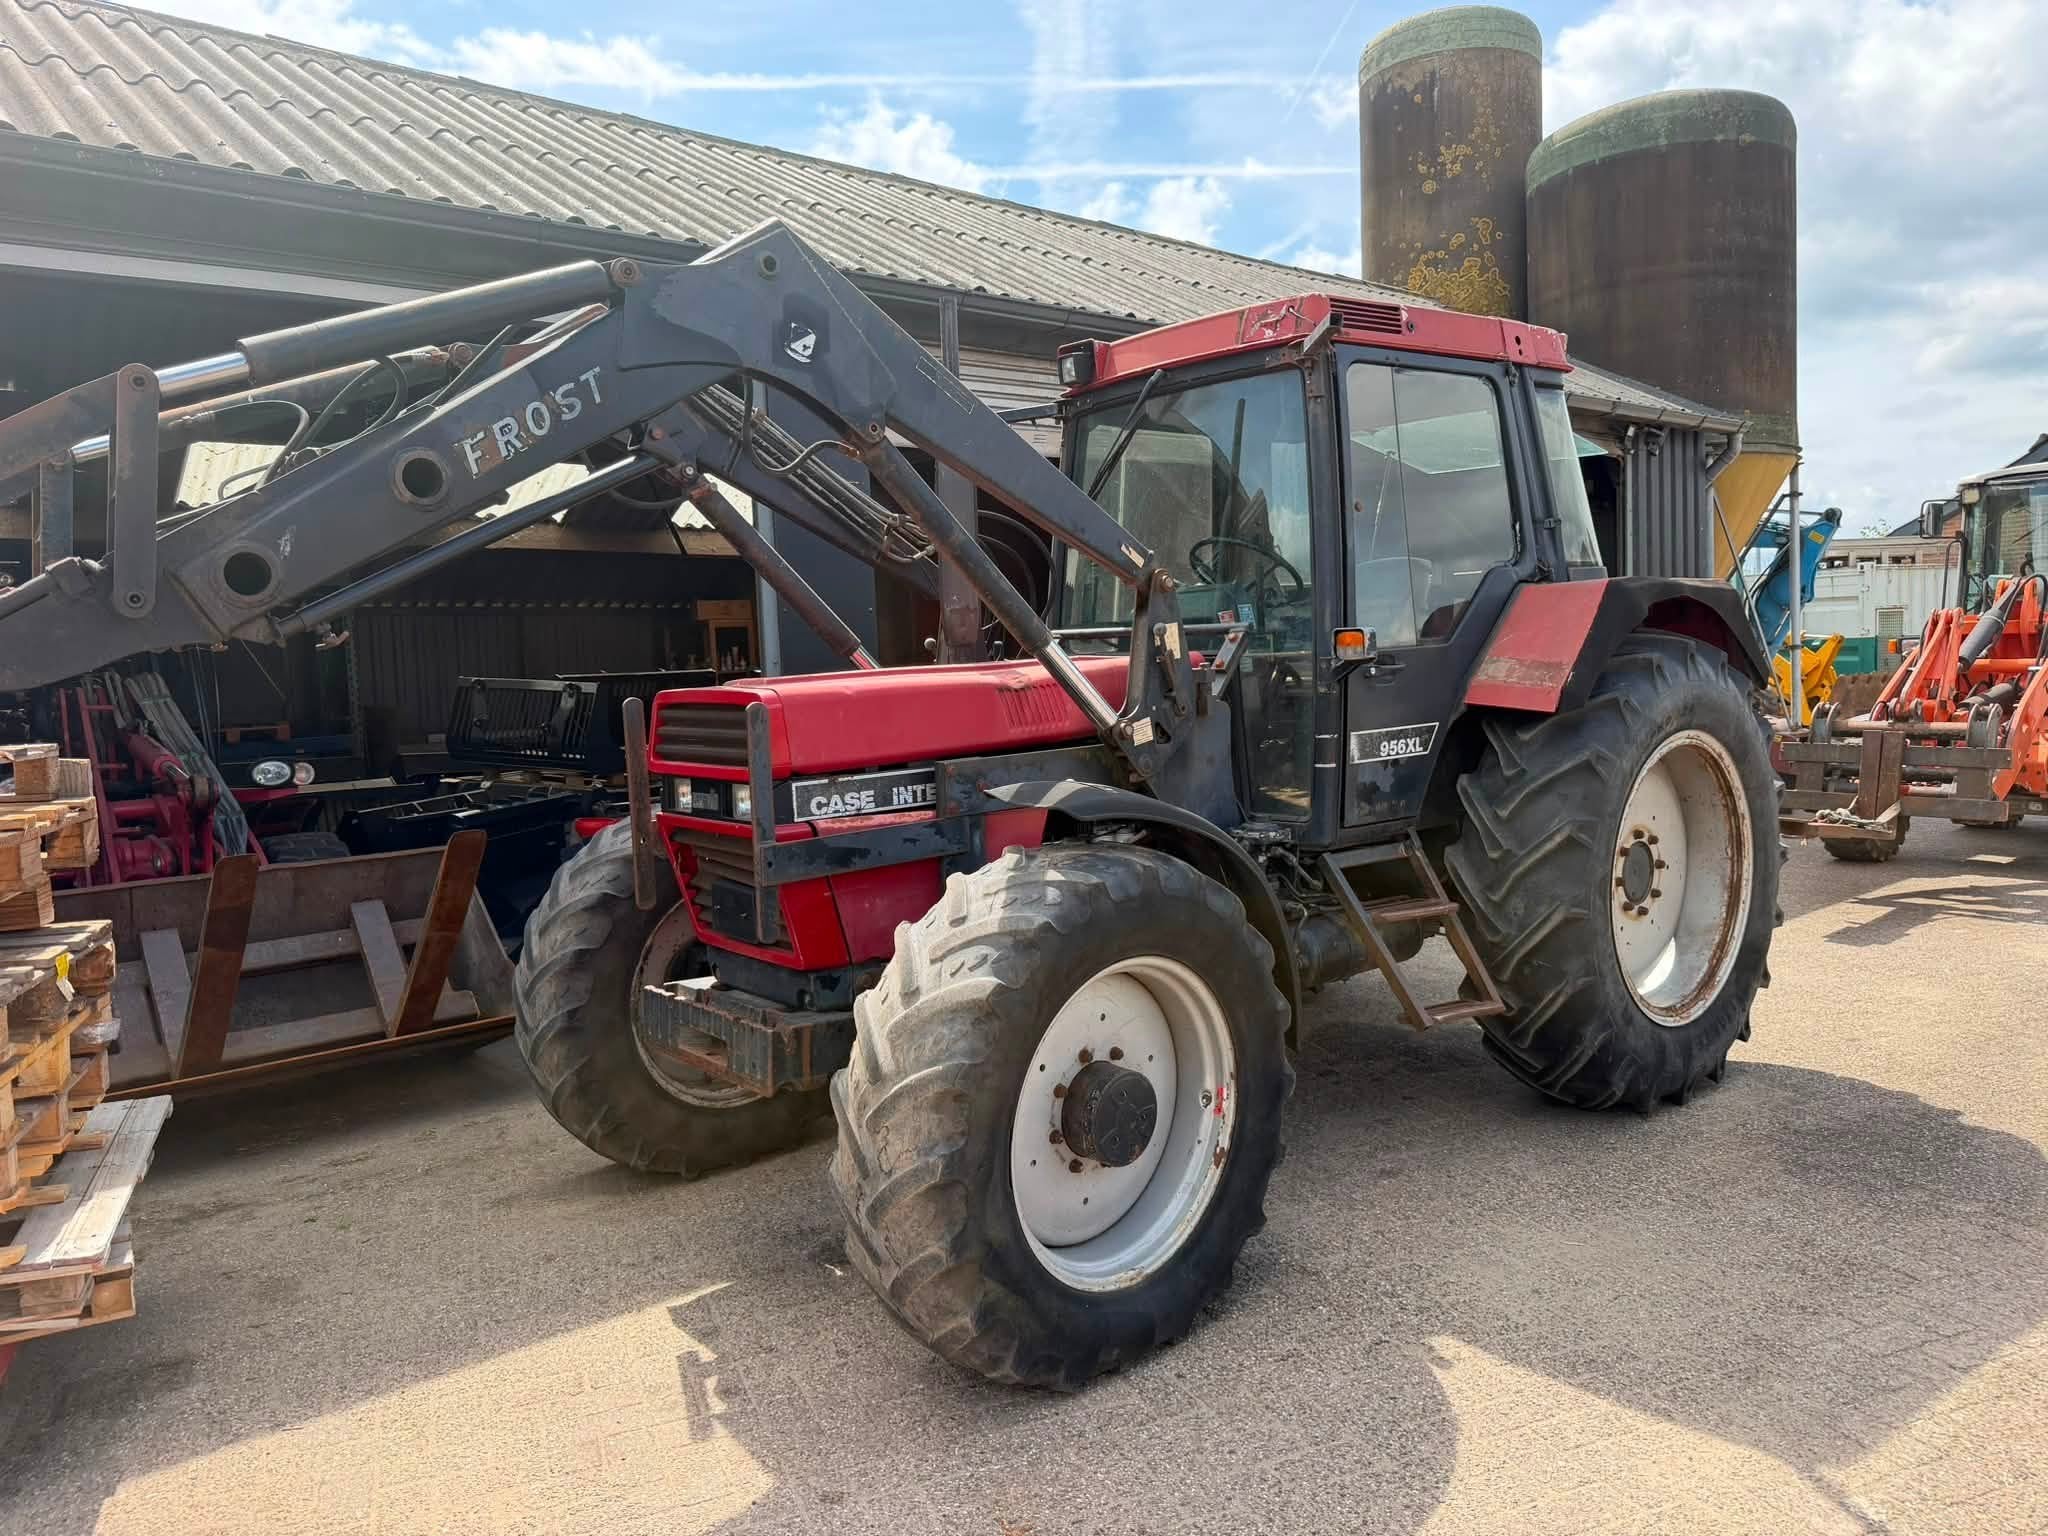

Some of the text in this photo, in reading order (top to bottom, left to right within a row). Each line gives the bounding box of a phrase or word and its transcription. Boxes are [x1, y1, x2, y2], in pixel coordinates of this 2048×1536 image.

[462, 366, 601, 479] FROST
[1380, 737, 1424, 757] 956XL
[810, 783, 936, 816] CASE INTE
